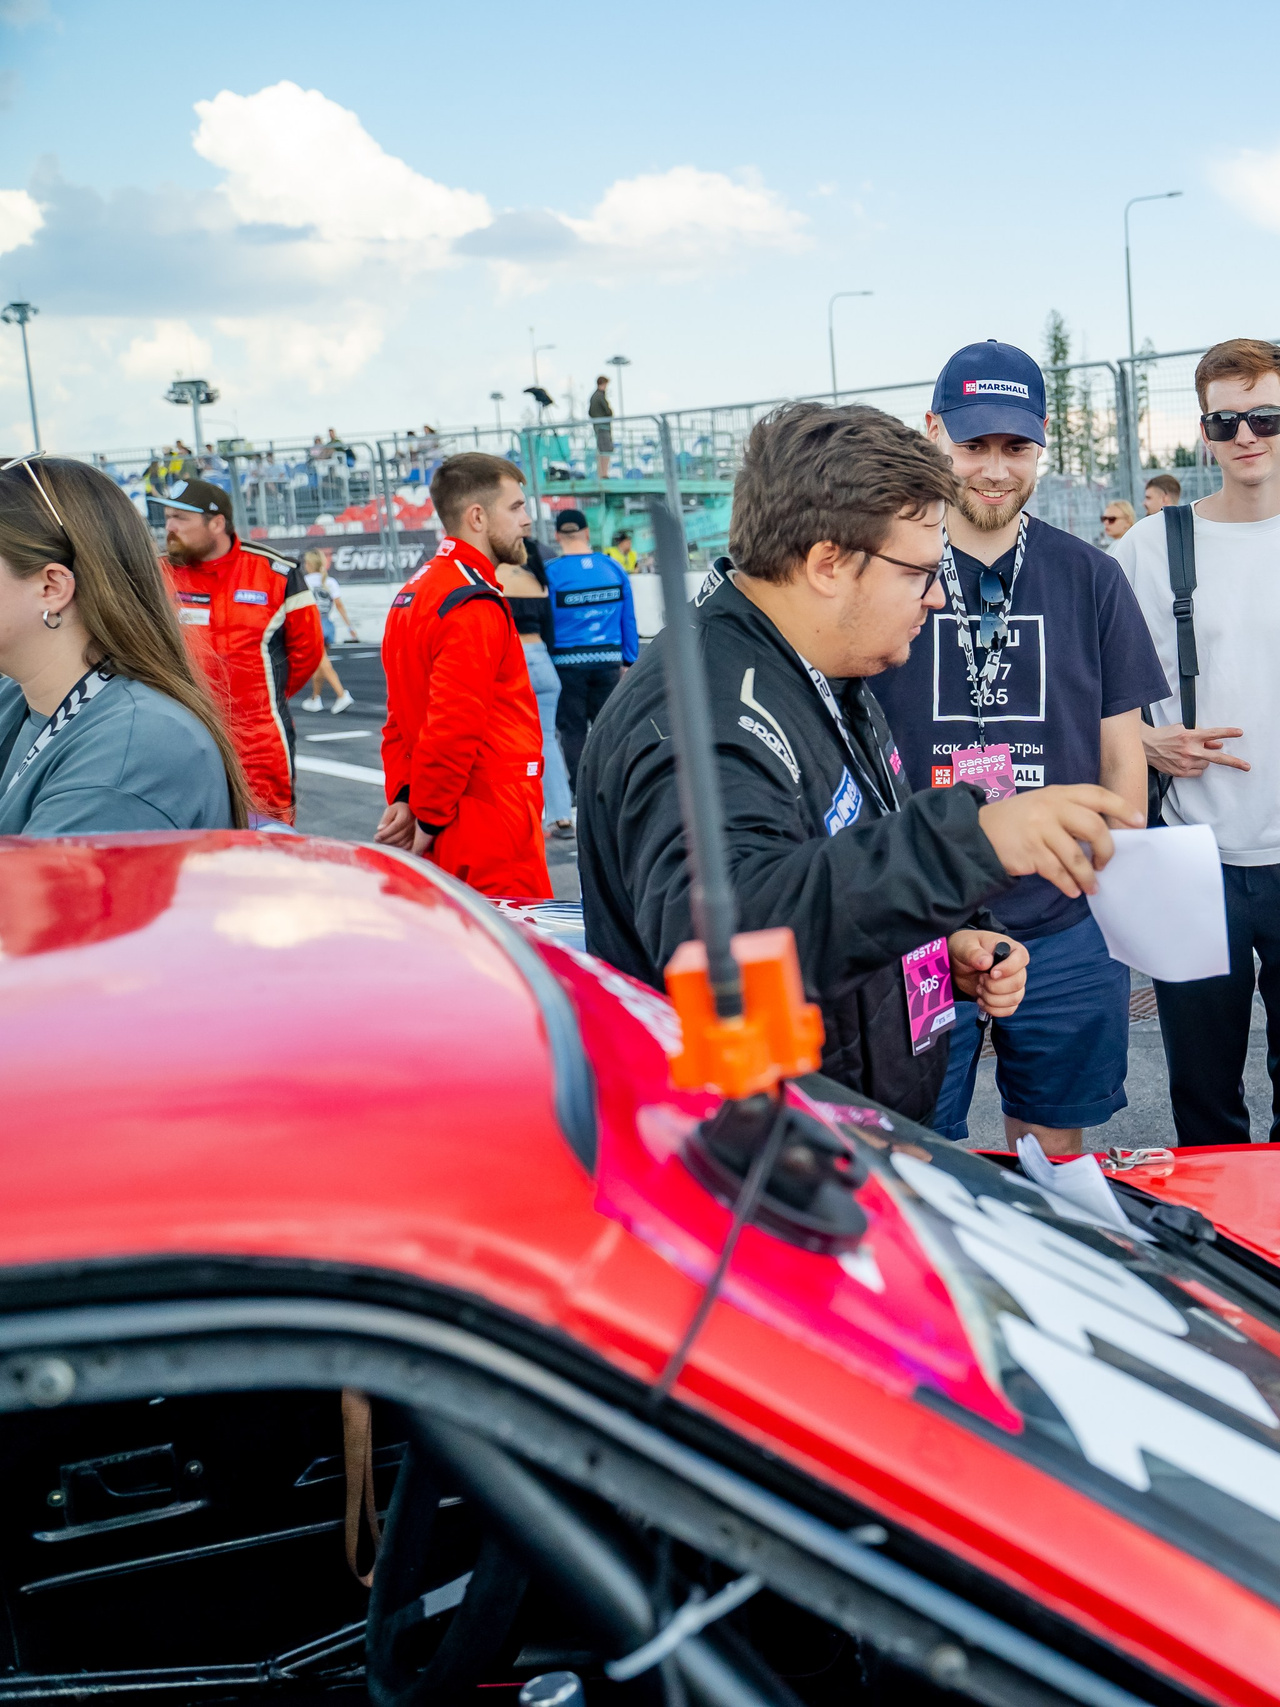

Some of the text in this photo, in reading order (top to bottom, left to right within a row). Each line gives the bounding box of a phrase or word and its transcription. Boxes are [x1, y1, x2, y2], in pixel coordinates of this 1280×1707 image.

[978, 383, 1027, 395] MARSHALL
[970, 688, 1009, 706] 365
[919, 974, 940, 996] RDS
